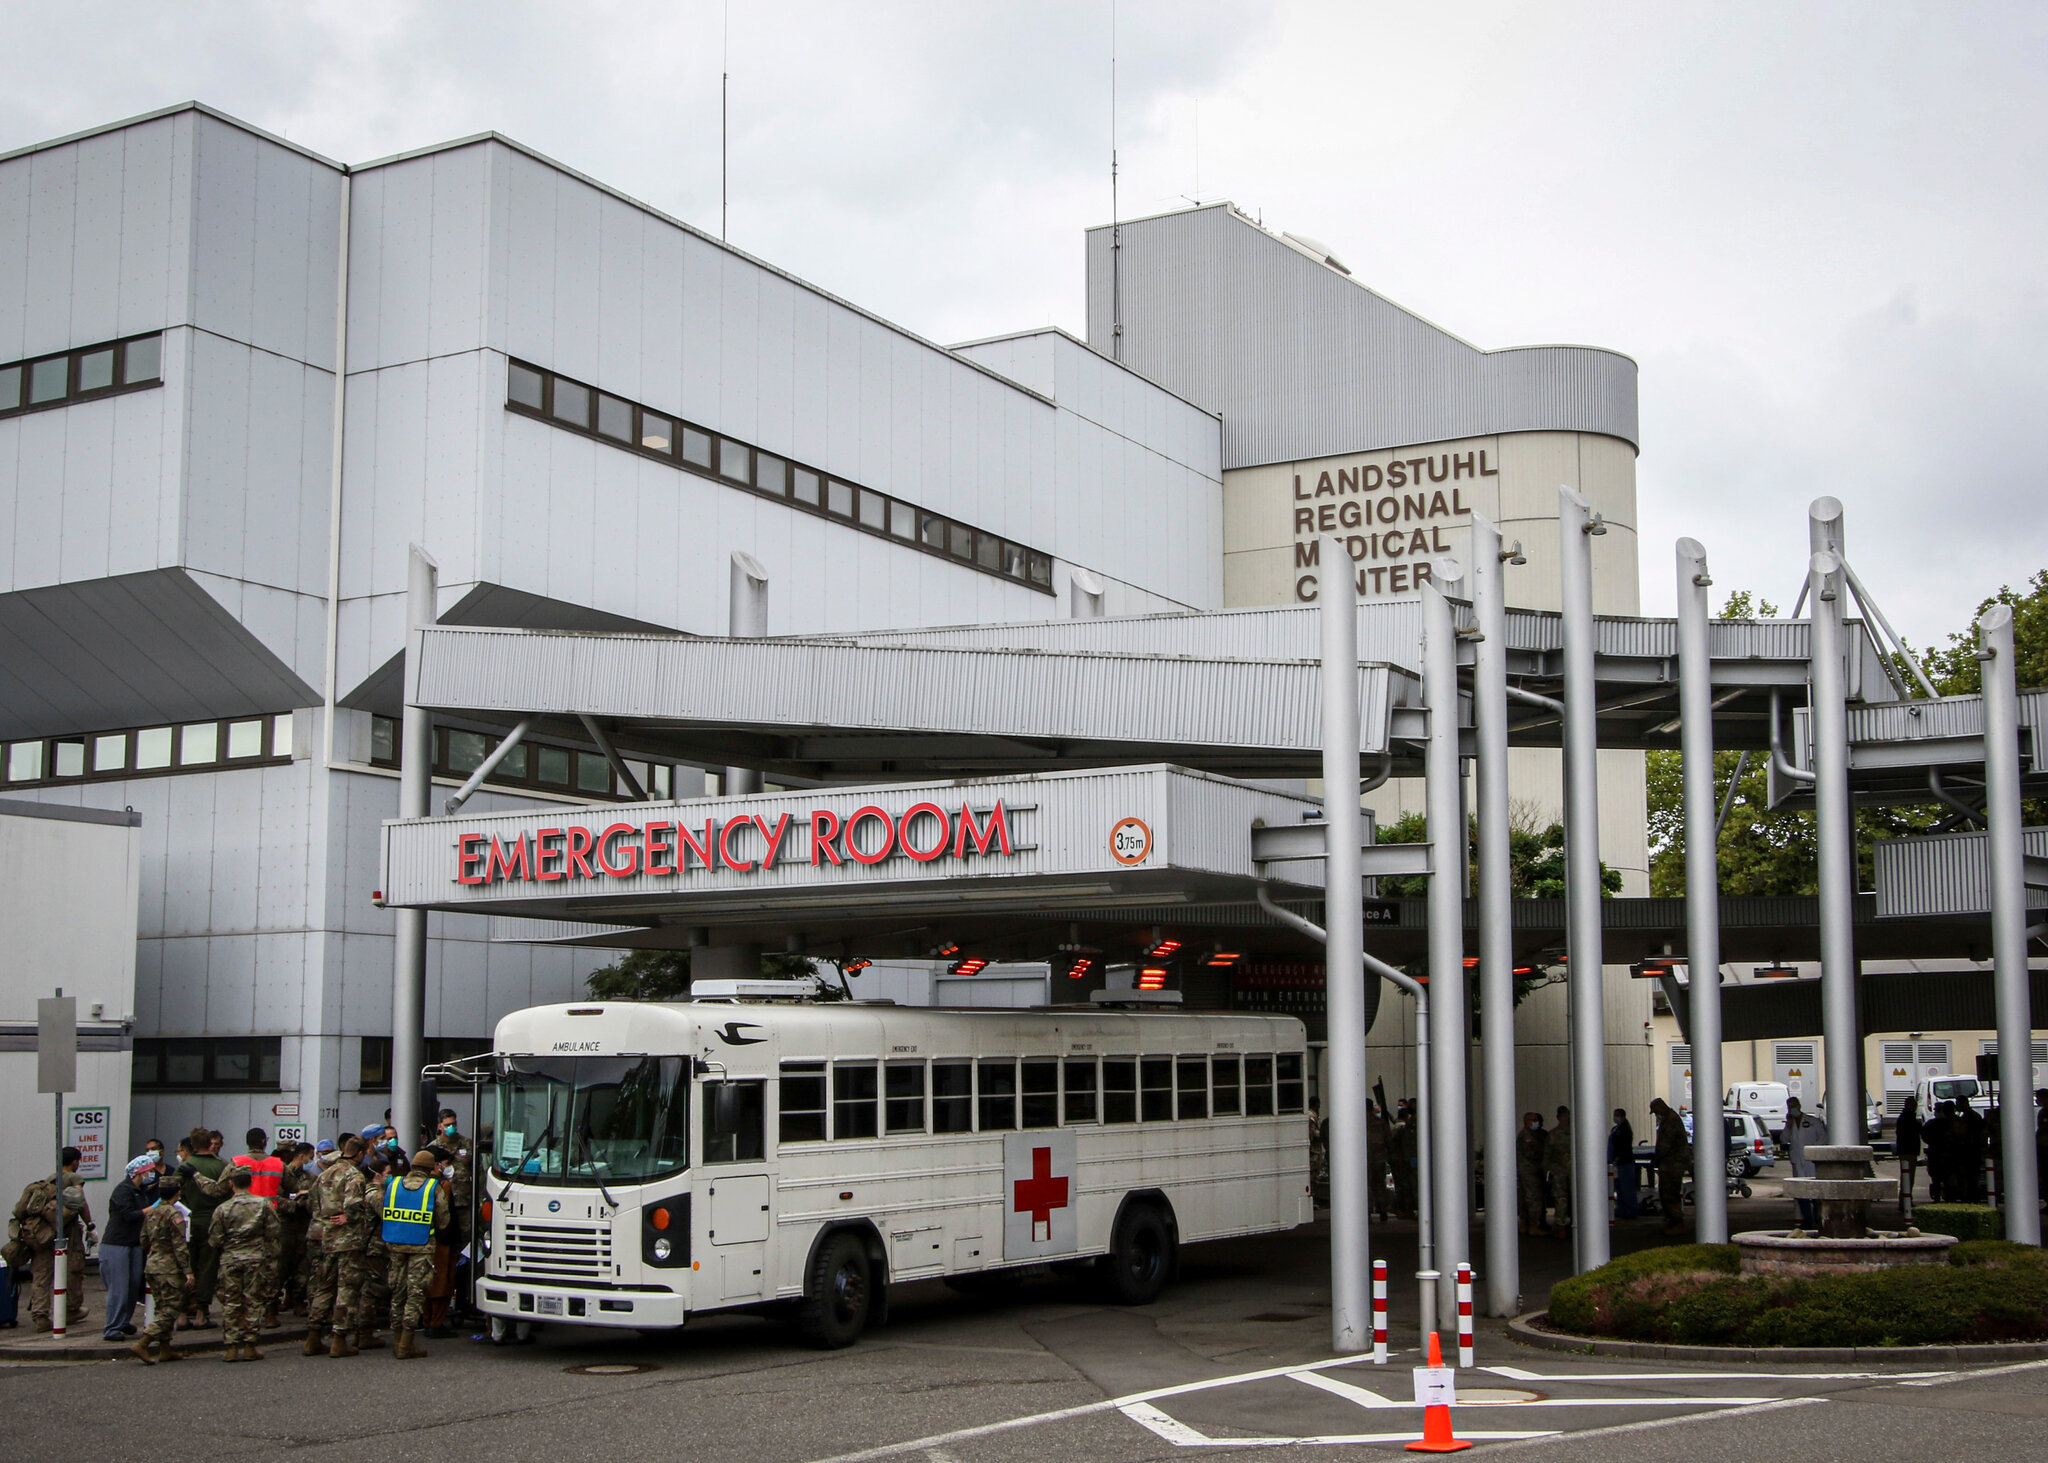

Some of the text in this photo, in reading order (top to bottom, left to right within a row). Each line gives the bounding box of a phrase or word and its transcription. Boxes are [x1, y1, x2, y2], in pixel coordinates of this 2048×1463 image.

[1295, 450, 1498, 500] LANDSTUHL
[1295, 488, 1471, 534] REGIONAL
[1295, 526, 1451, 568] MDICAL
[1296, 562, 1432, 602] CNTER
[457, 798, 1014, 885] EMERGENCY ROOM
[1382, 908, 1392, 920] A
[1278, 991, 1326, 1001] ENTRAN
[552, 1041, 601, 1052] AMBULANCE
[75, 1112, 103, 1124] CSC
[78, 1134, 99, 1142] LINE
[279, 1128, 302, 1139] CSC
[74, 1144, 104, 1153] TARTS
[384, 1209, 431, 1222] POLICE
